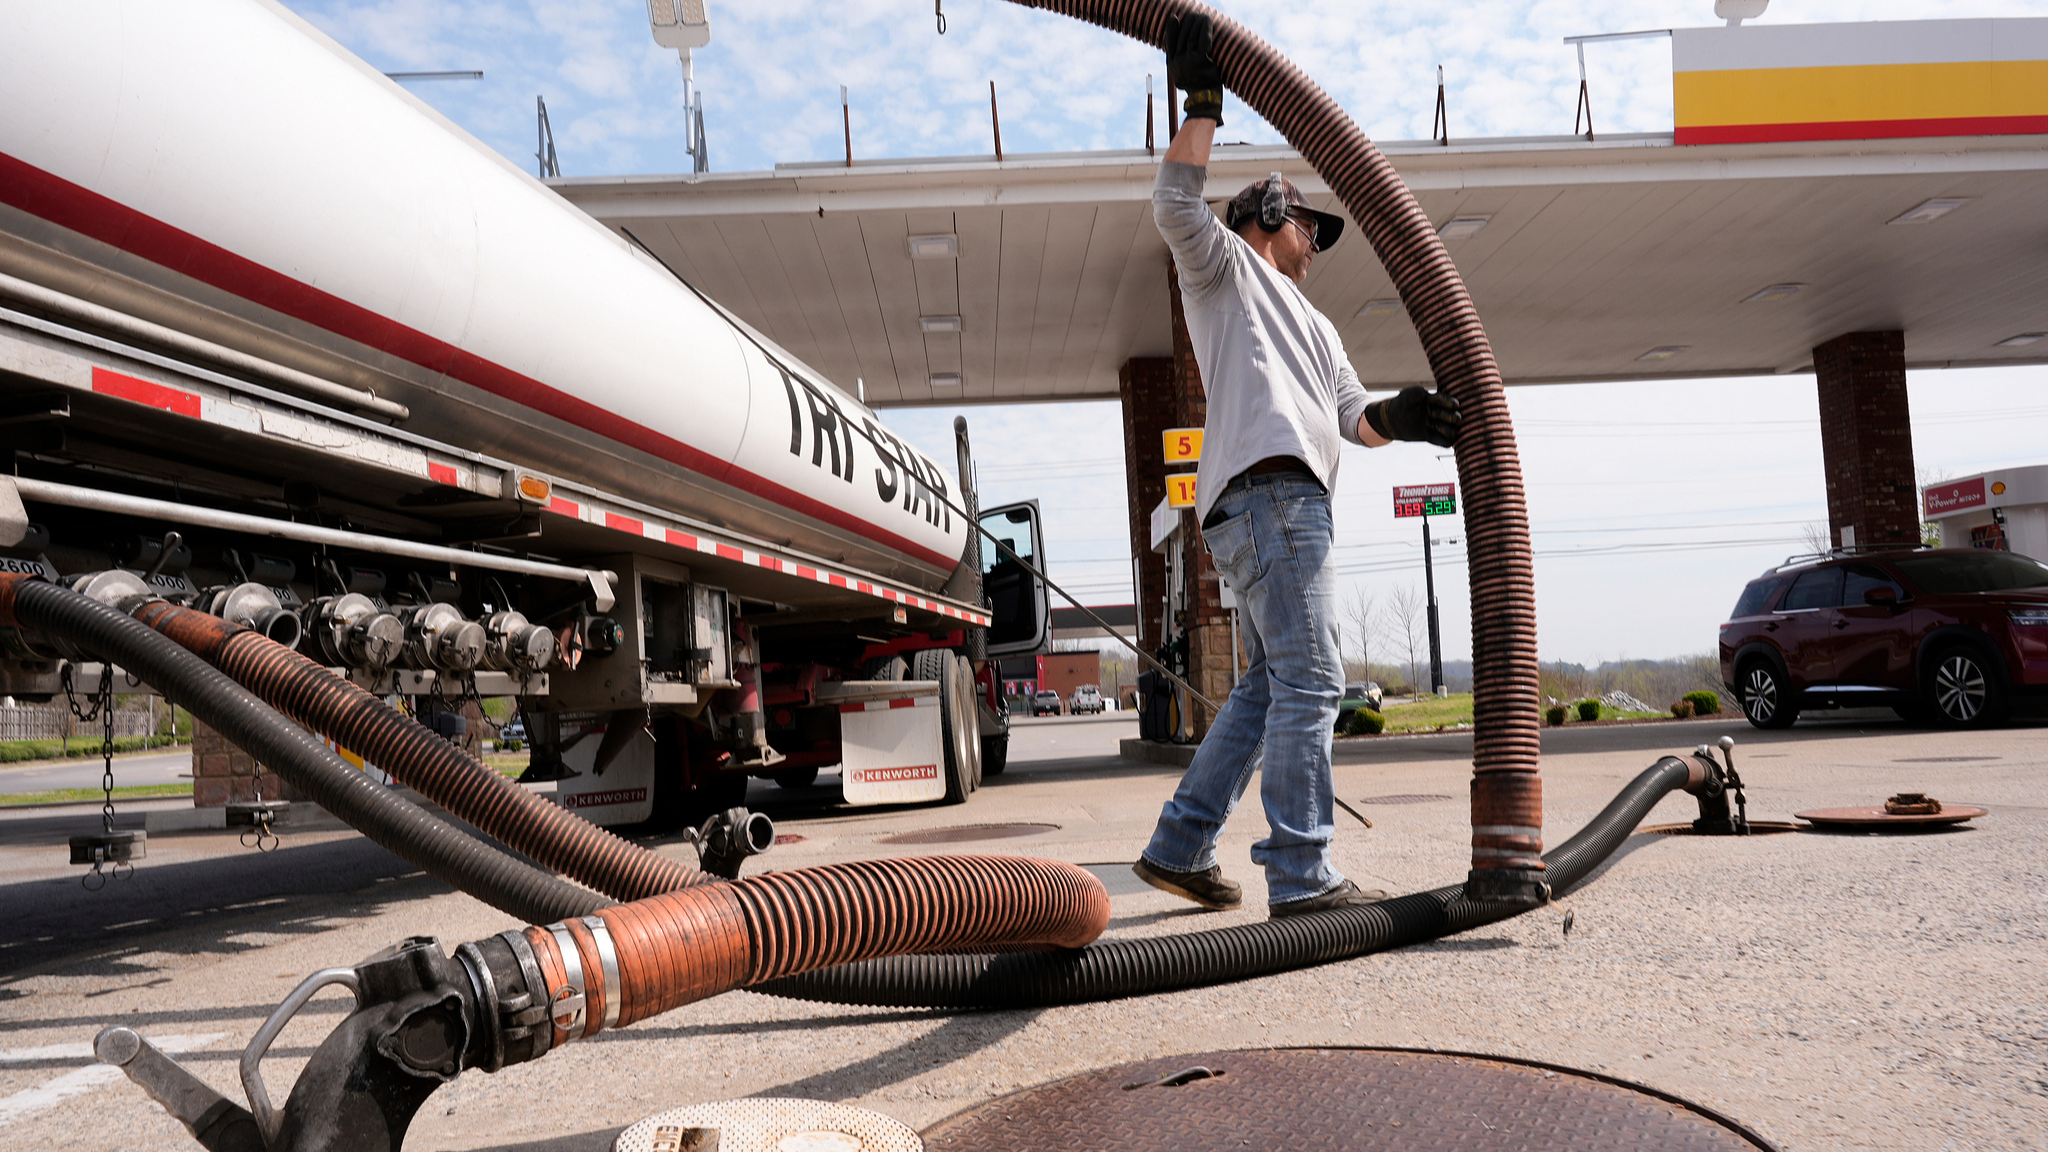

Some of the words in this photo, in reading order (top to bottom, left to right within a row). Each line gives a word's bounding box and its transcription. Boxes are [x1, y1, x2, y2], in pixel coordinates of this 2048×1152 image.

[764, 354, 854, 484] TRI
[862, 416, 950, 534] STAR
[1178, 436, 1192, 456] 5
[866, 767, 935, 781] KENWORTH
[579, 790, 645, 806] KENWORTH
